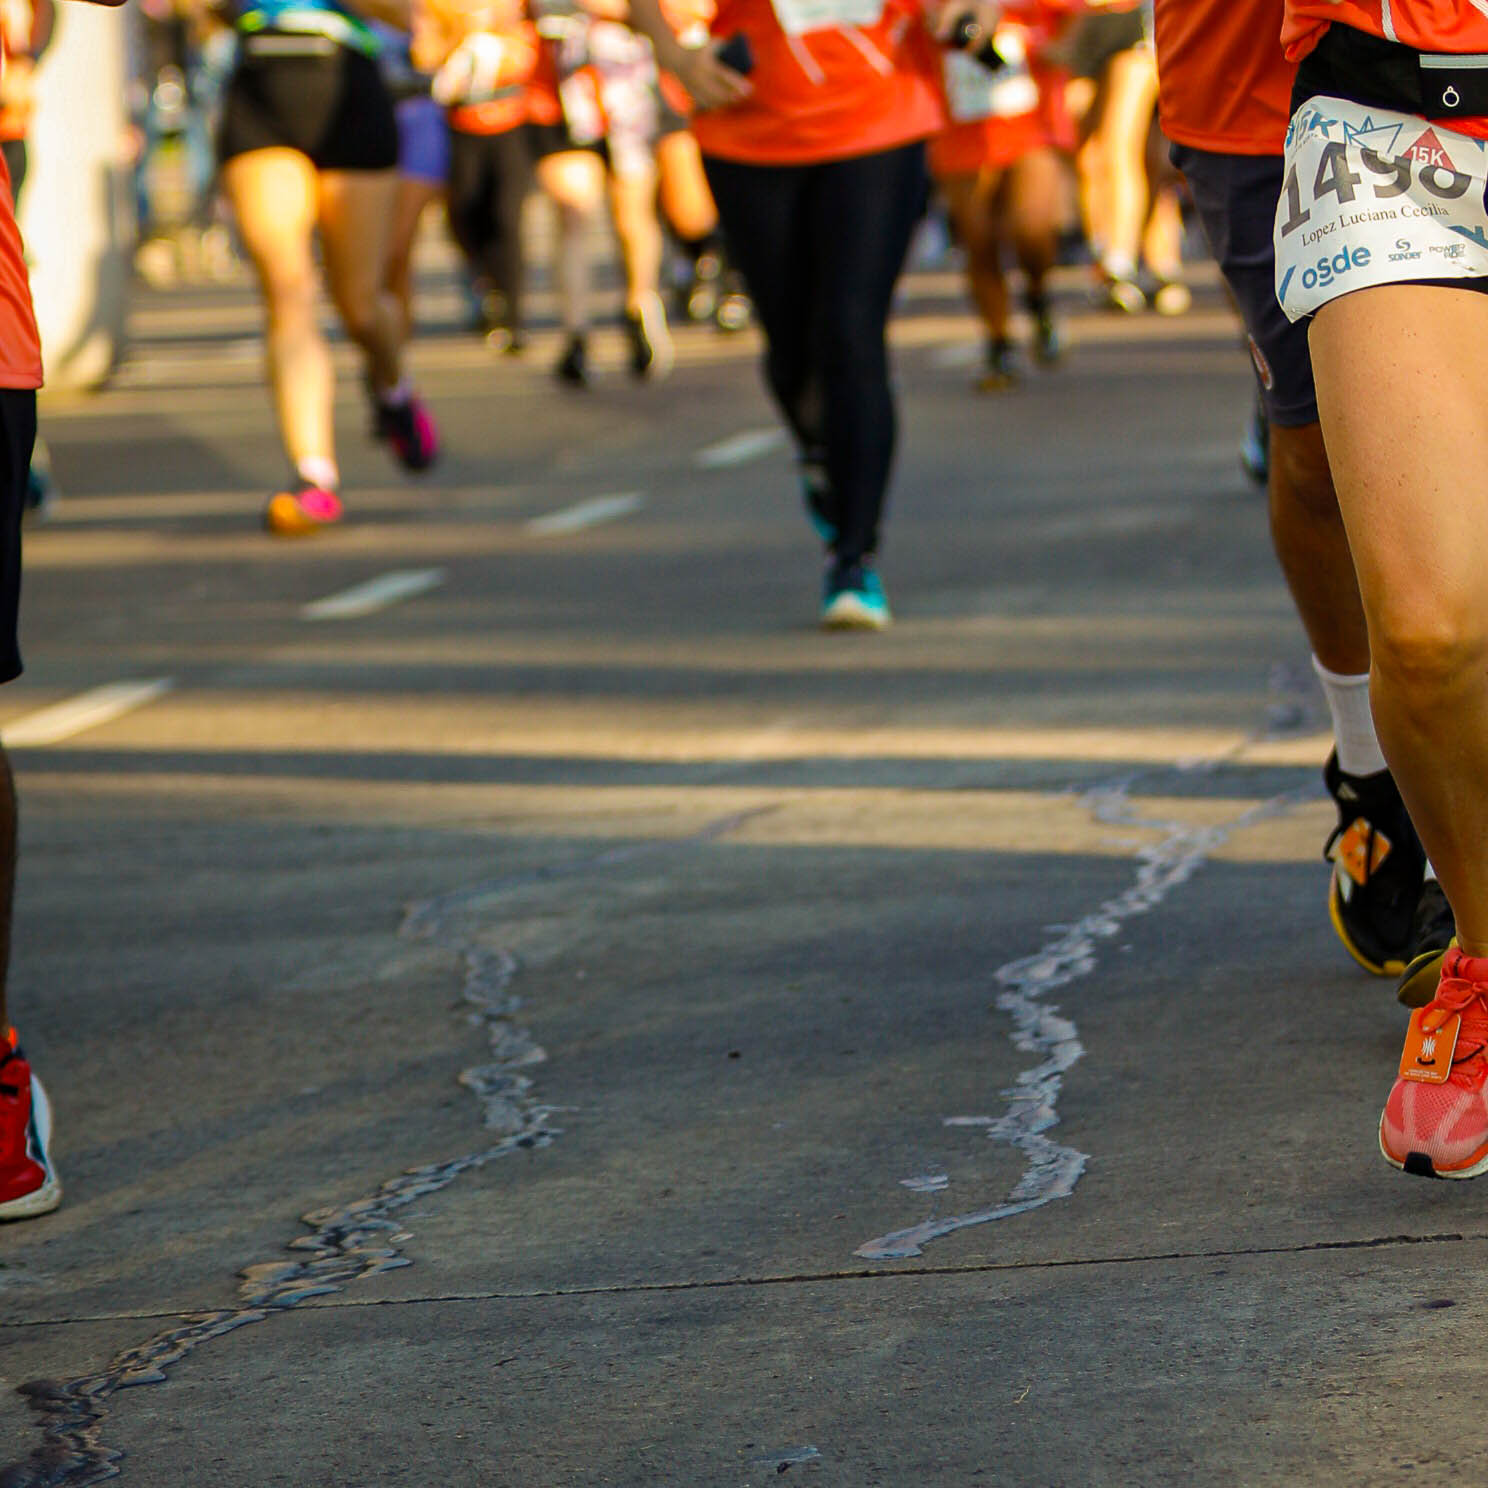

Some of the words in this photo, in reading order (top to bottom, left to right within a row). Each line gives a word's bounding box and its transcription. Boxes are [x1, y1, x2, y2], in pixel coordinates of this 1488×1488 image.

[1410, 146, 1444, 166] 15K
[1301, 220, 1337, 247] Lopez
[1339, 207, 1397, 228] Luciana
[1400, 202, 1450, 218] Cecilia
[1302, 245, 1372, 289] osde
